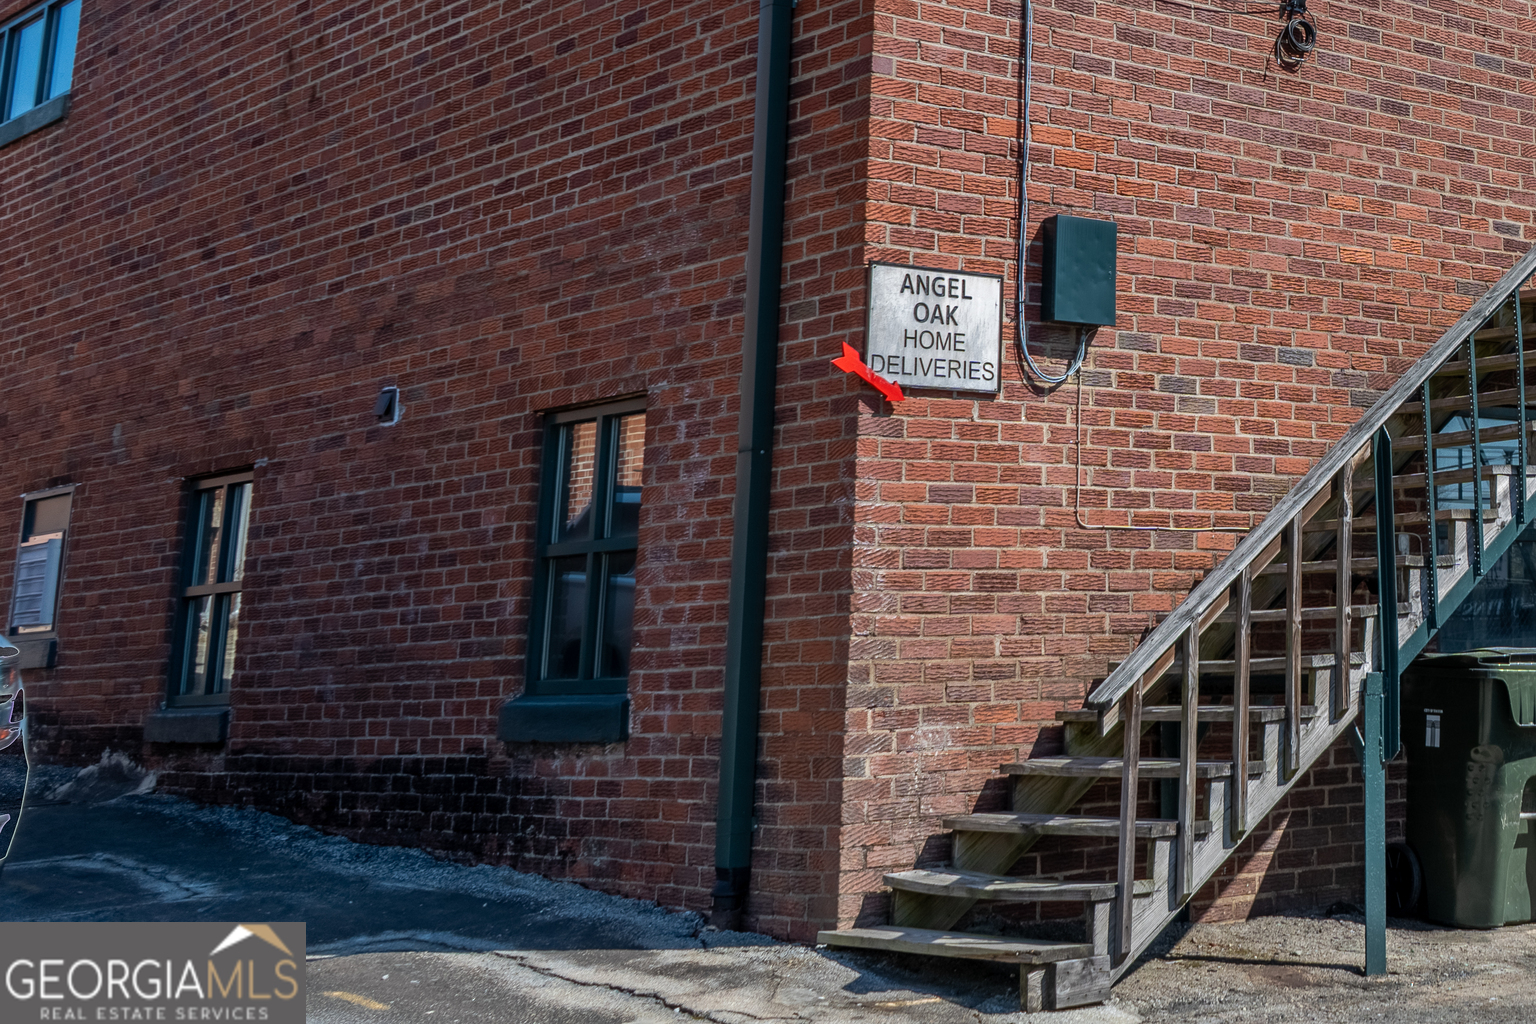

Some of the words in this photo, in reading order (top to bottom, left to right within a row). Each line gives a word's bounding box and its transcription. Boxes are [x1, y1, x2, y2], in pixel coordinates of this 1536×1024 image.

[900, 273, 973, 300] ANGEL
[913, 302, 959, 326] OAK
[904, 329, 966, 352] HOME
[870, 354, 995, 382] DELIVERIES
